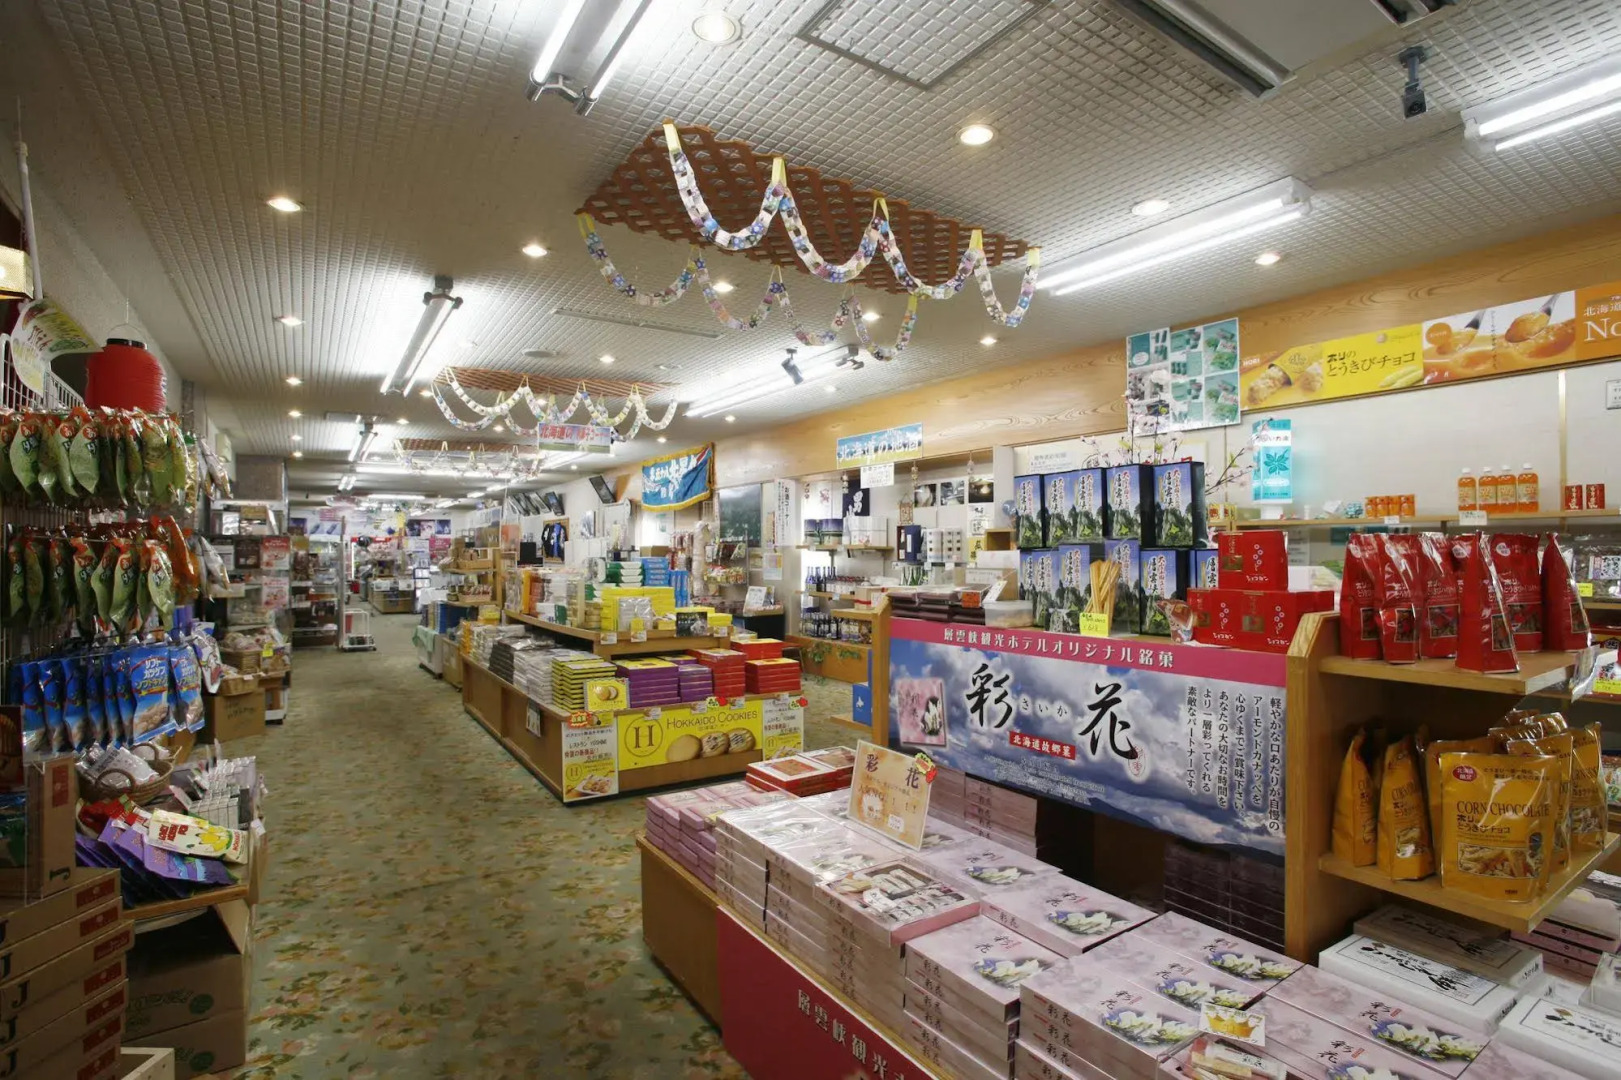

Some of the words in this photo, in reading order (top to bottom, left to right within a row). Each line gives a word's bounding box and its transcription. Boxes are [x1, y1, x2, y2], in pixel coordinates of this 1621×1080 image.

[1326, 350, 1357, 364] ホリの
[1327, 351, 1416, 377] とうきびチョコ
[943, 628, 1175, 668] 層雲峡観光ホテルオリジナル銘菓
[666, 714, 717, 729] HOKKAIDO
[717, 710, 758, 722] COOKIES
[965, 663, 1013, 729] 彩
[1020, 698, 1068, 718] さいか
[1079, 682, 1139, 760] 花
[1186, 685, 1198, 796] 素敵なパートナーです。
[1201, 688, 1213, 794] より一層彩ってくれる
[1217, 690, 1229, 809] あなたの大切なお時間を
[1234, 693, 1246, 818] 心ゆくまでご賞味下さい。
[1251, 695, 1264, 806] アーモンドカナッペを
[865, 753, 879, 773] 彩
[905, 767, 920, 789] 花
[1268, 697, 1283, 832] 軽やかな口あたりが自慢の
[1456, 800, 1486, 815] CORN
[1489, 802, 1551, 818] CHOCOLATE
